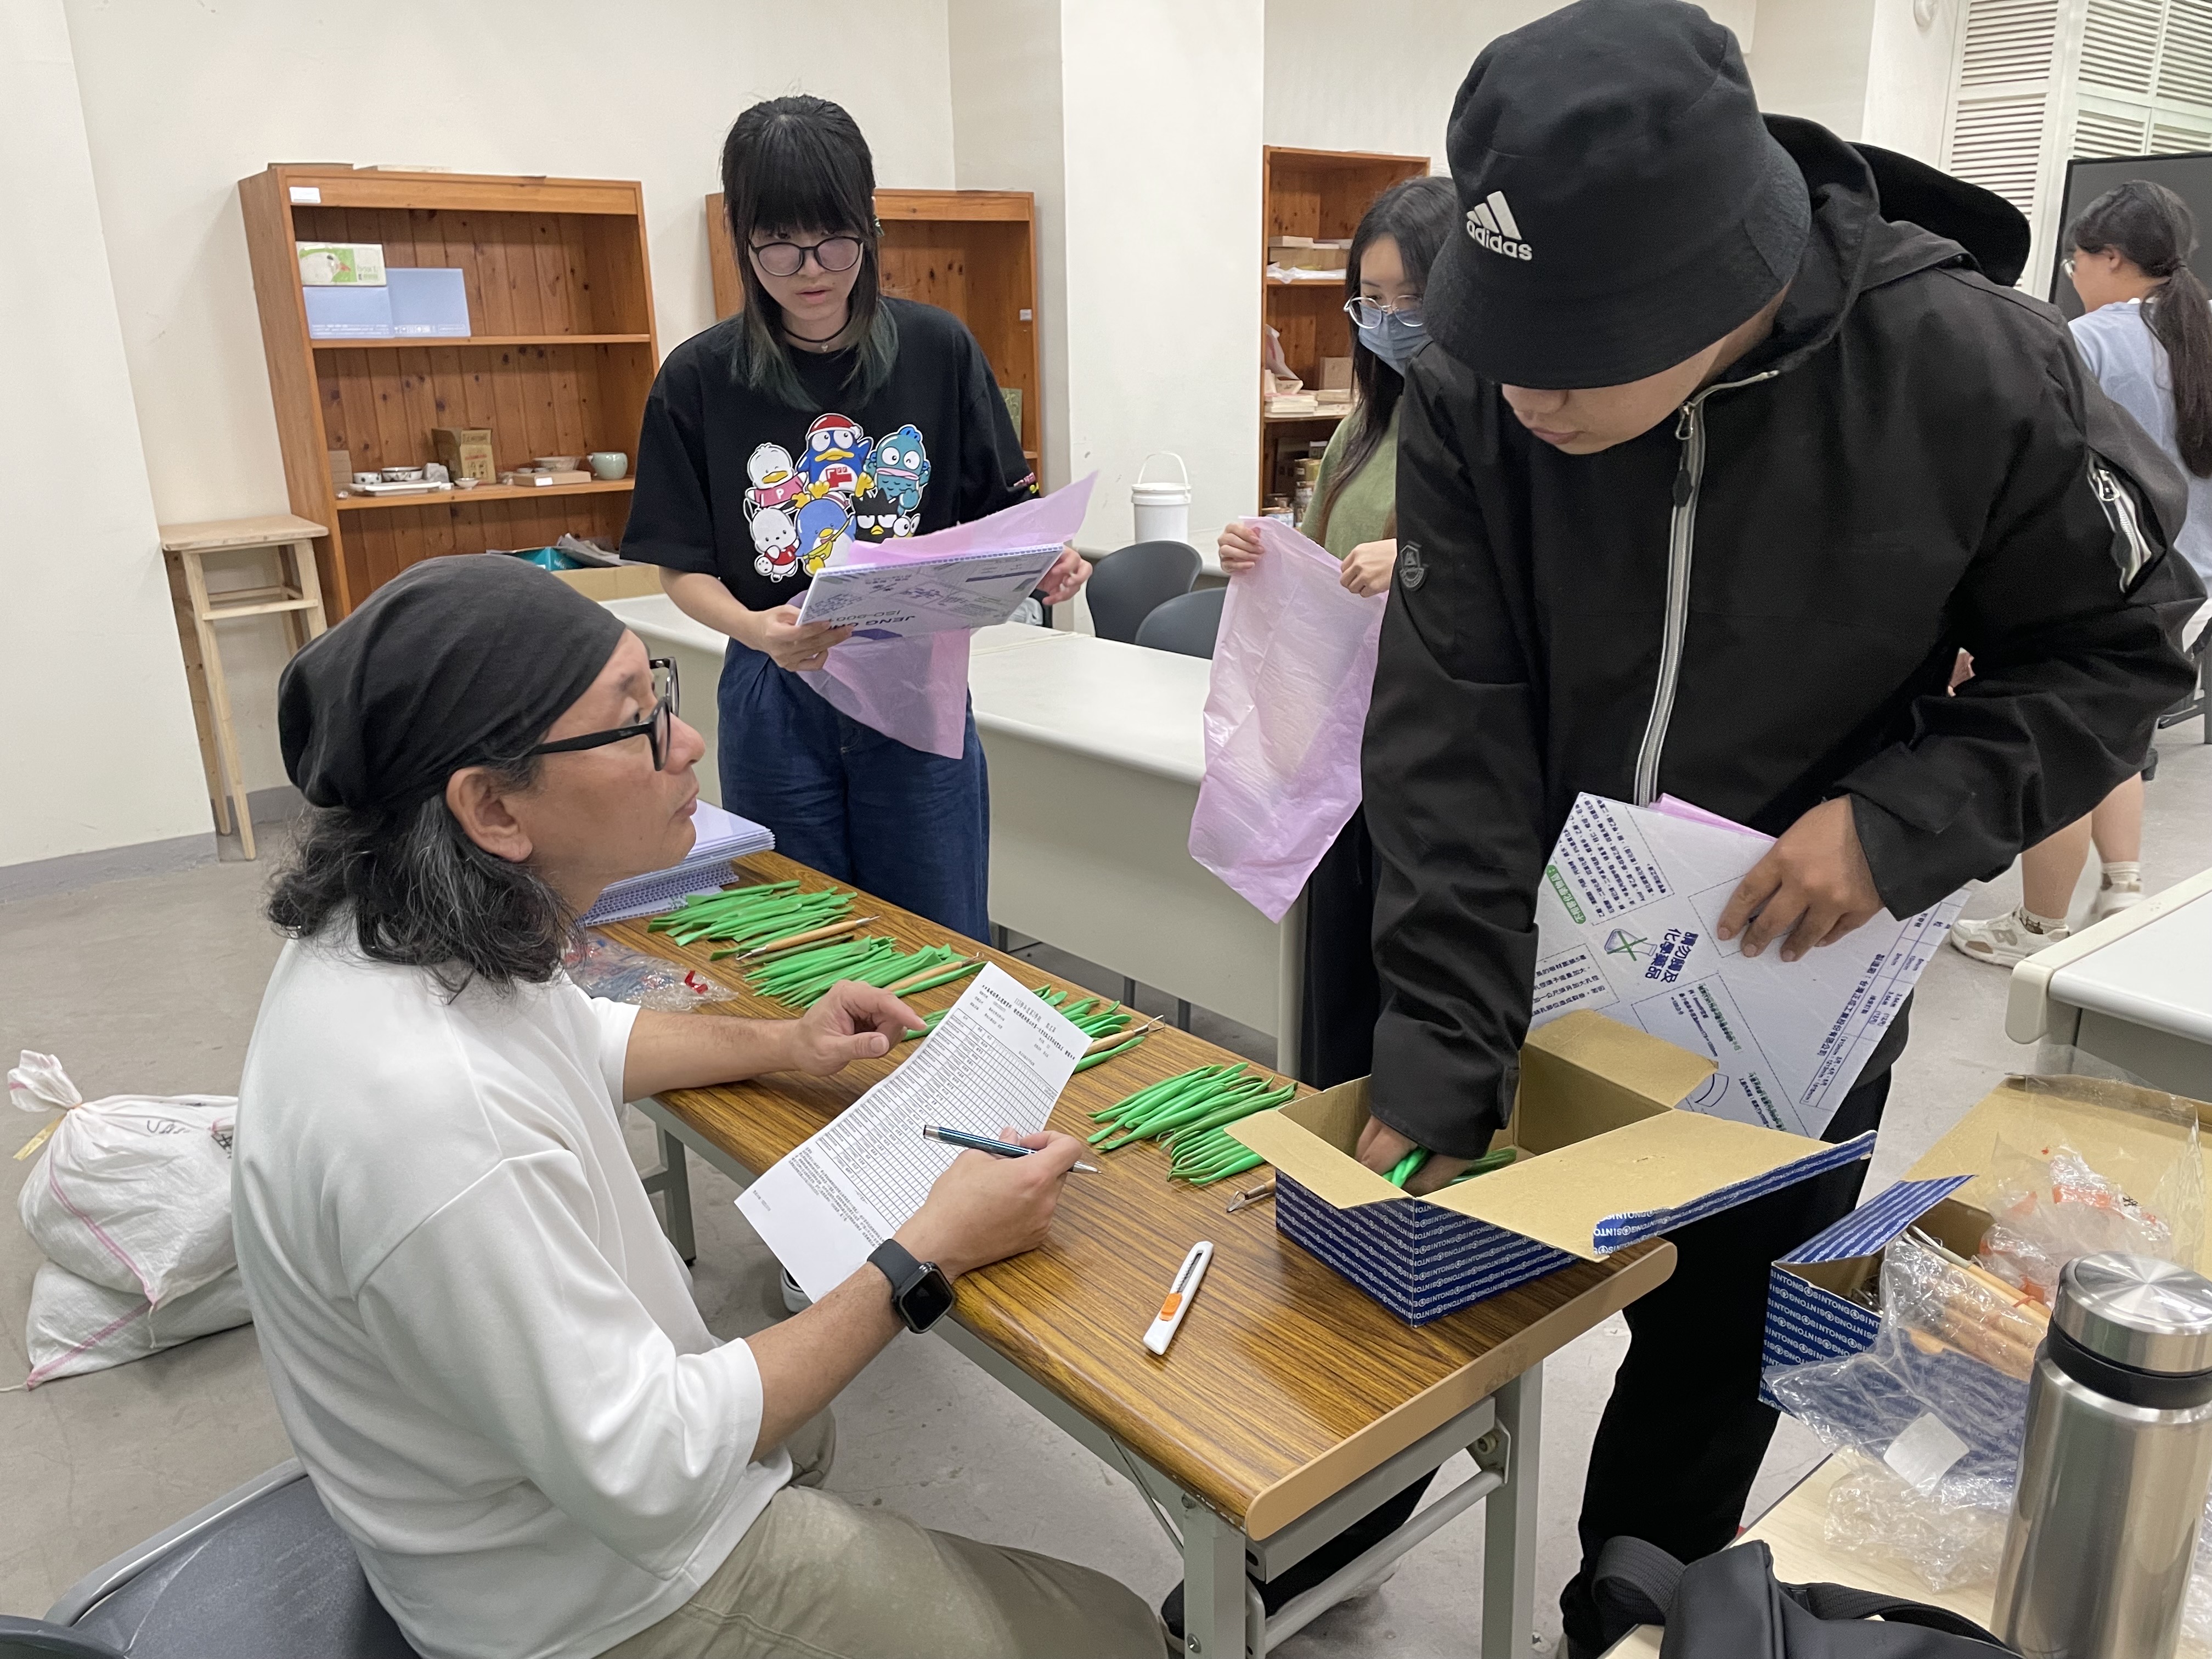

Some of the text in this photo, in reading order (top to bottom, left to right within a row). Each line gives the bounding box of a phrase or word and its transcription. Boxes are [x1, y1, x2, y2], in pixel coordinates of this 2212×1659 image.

[1466, 220, 1533, 261] adidas
[776, 488, 785, 500] P
[865, 615, 915, 626] JENG
[1417, 1228, 1437, 1242] SINTO
[1593, 1228, 1622, 1236] SINTO
[1417, 1255, 1437, 1268] SINTO
[1416, 1280, 1436, 1294] SINTO
[1813, 1290, 1850, 1315] SINTONG
[1415, 1307, 1436, 1321] SINTO
[1788, 1293, 1872, 1341] SINTONG SINTONG
[1786, 1321, 1823, 1346] SINTONG
[1810, 1318, 1848, 1344] SINTONG
